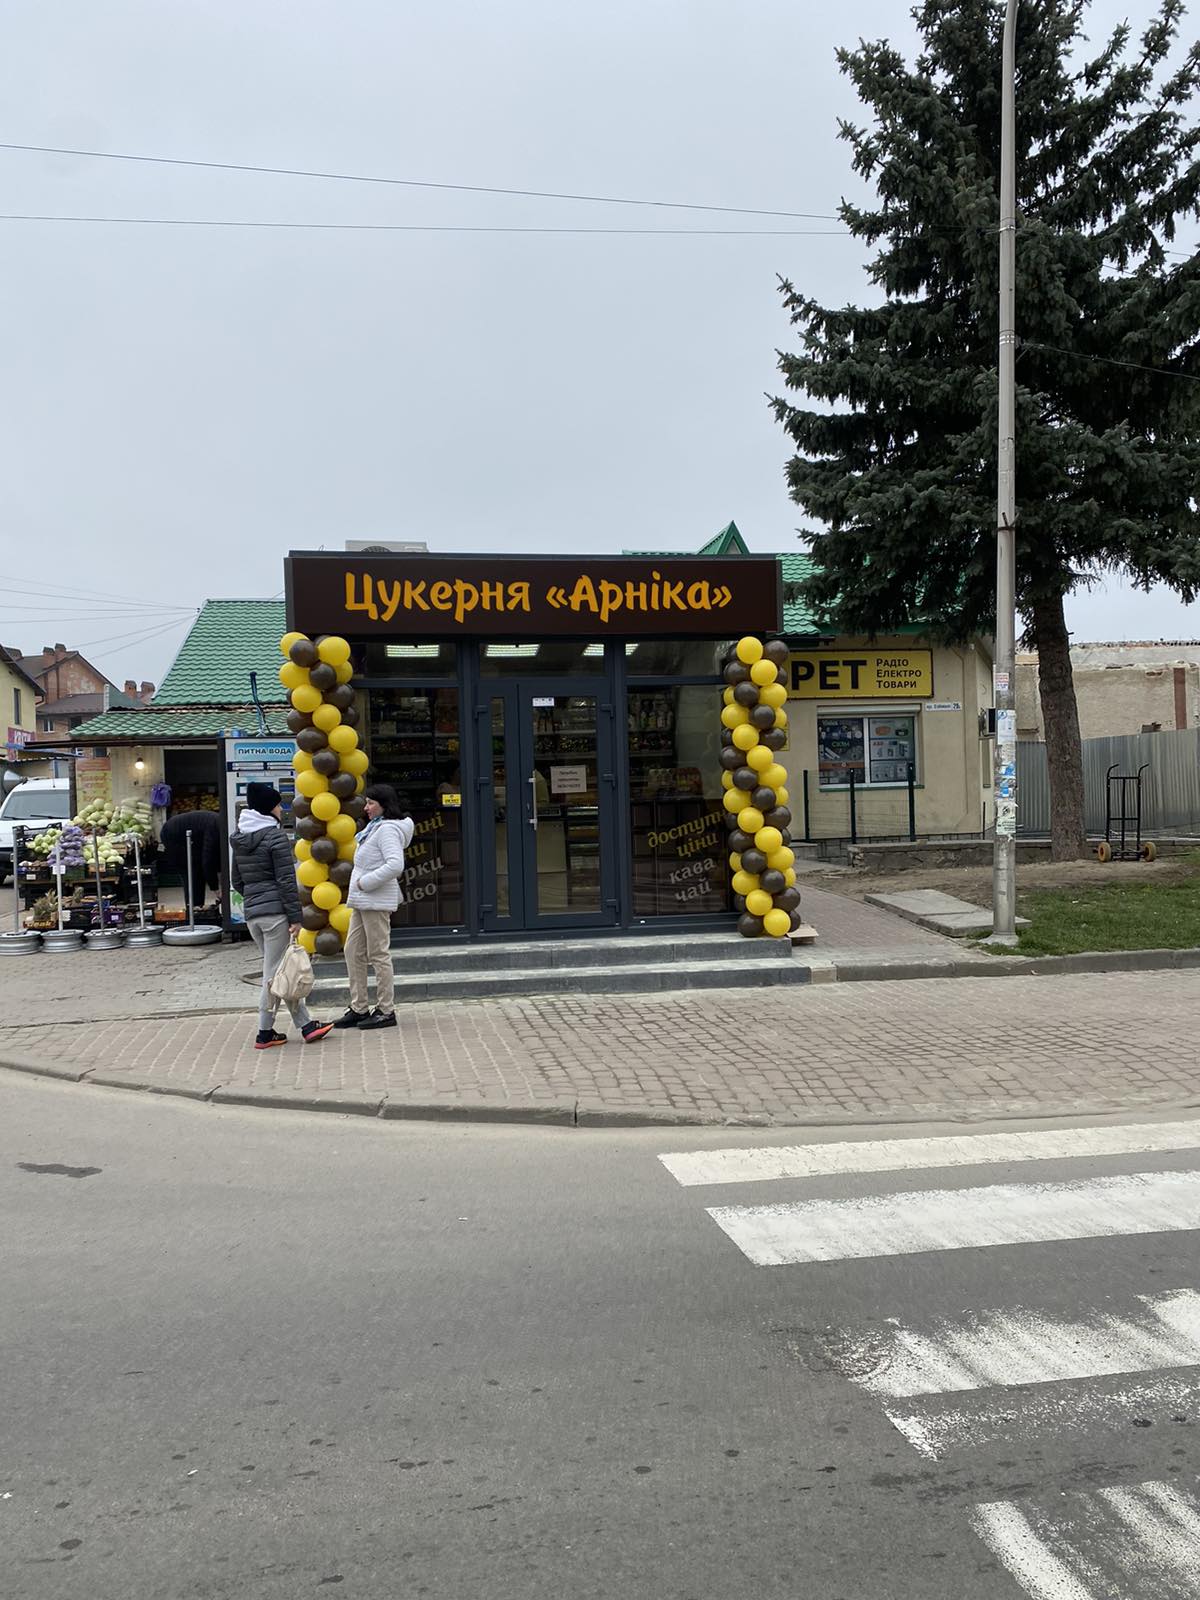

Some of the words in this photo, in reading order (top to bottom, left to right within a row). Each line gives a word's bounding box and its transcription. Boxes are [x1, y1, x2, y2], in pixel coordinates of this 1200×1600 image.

[345, 571, 531, 623] Цукерня
[546, 571, 732, 623] «Арніка»
[876, 658, 909, 667] РАДІО
[876, 669, 922, 678] ЕЛЕКТРО
[791, 660, 867, 691] РЕТ
[876, 680, 917, 689] ТОВАРИ
[676, 832, 719, 858] ціни
[669, 857, 716, 884] кава
[674, 877, 712, 902] чай
